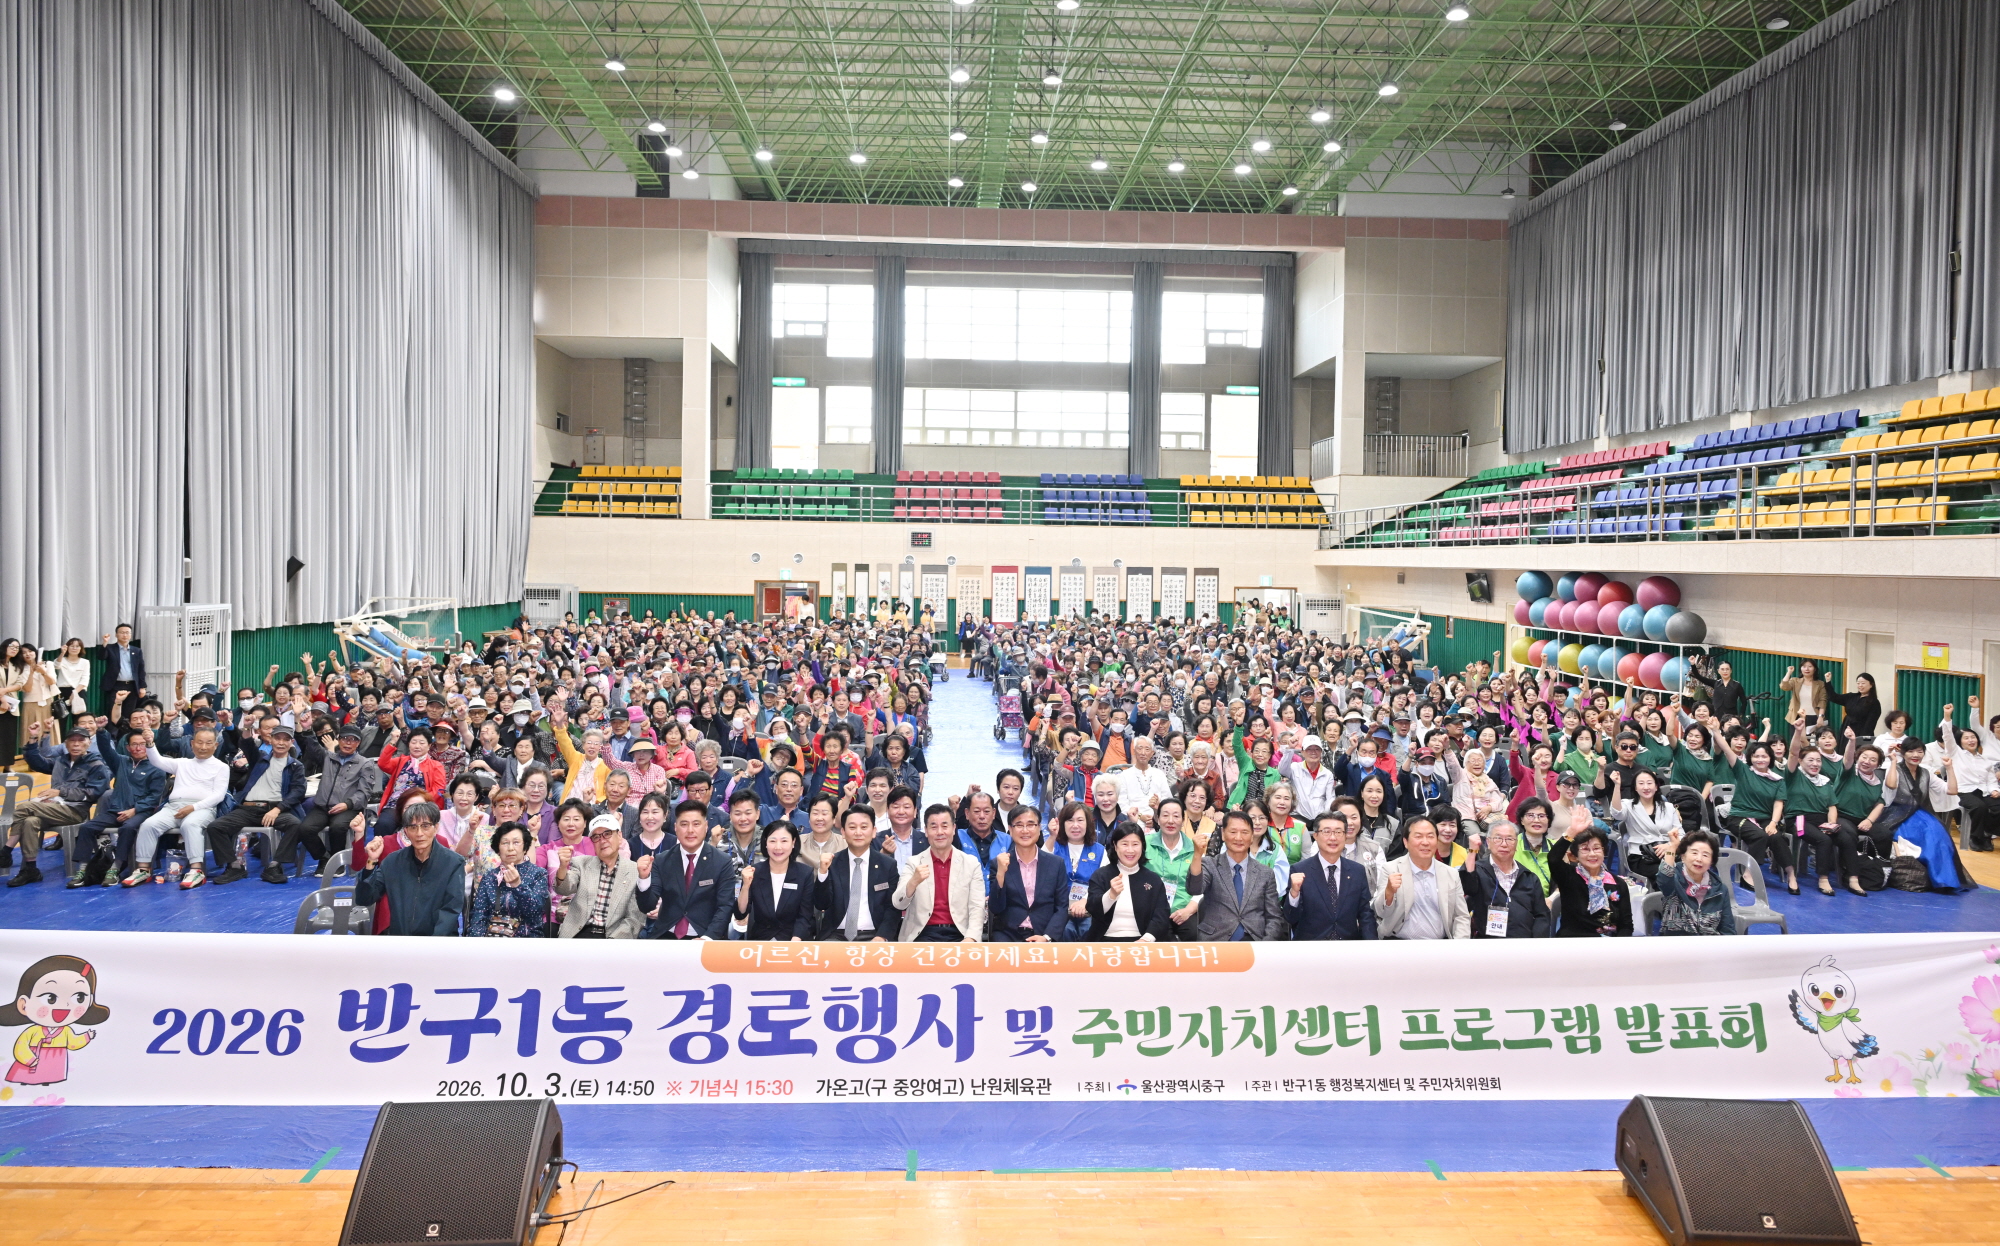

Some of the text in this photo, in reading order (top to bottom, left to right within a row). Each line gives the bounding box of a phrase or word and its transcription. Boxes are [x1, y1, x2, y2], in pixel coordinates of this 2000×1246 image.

[739, 944, 1220, 968] 어르신, 항상 건강하세요! 사랑합니다!
[146, 983, 1768, 1065] 2026 반구1동 경로행사 및 주민자치센터 프로그램 발표회
[436, 1080, 486, 1097] 2026.
[495, 1072, 534, 1097] 10.
[606, 1080, 655, 1096] 14:50
[689, 1079, 738, 1097] 기념식
[746, 1080, 794, 1095] 15:30
[815, 1078, 888, 1097] 가온고(구
[892, 1078, 965, 1097] 중앙여고)
[970, 1077, 1053, 1096] 난원체육관
[1140, 1079, 1226, 1094] 울산광역시중구
[1282, 1078, 1327, 1093] 반구1동
[1329, 1078, 1400, 1093] 행정복지센터
[1403, 1077, 1416, 1093] 및
[1418, 1076, 1502, 1092] 주민자치위원회
